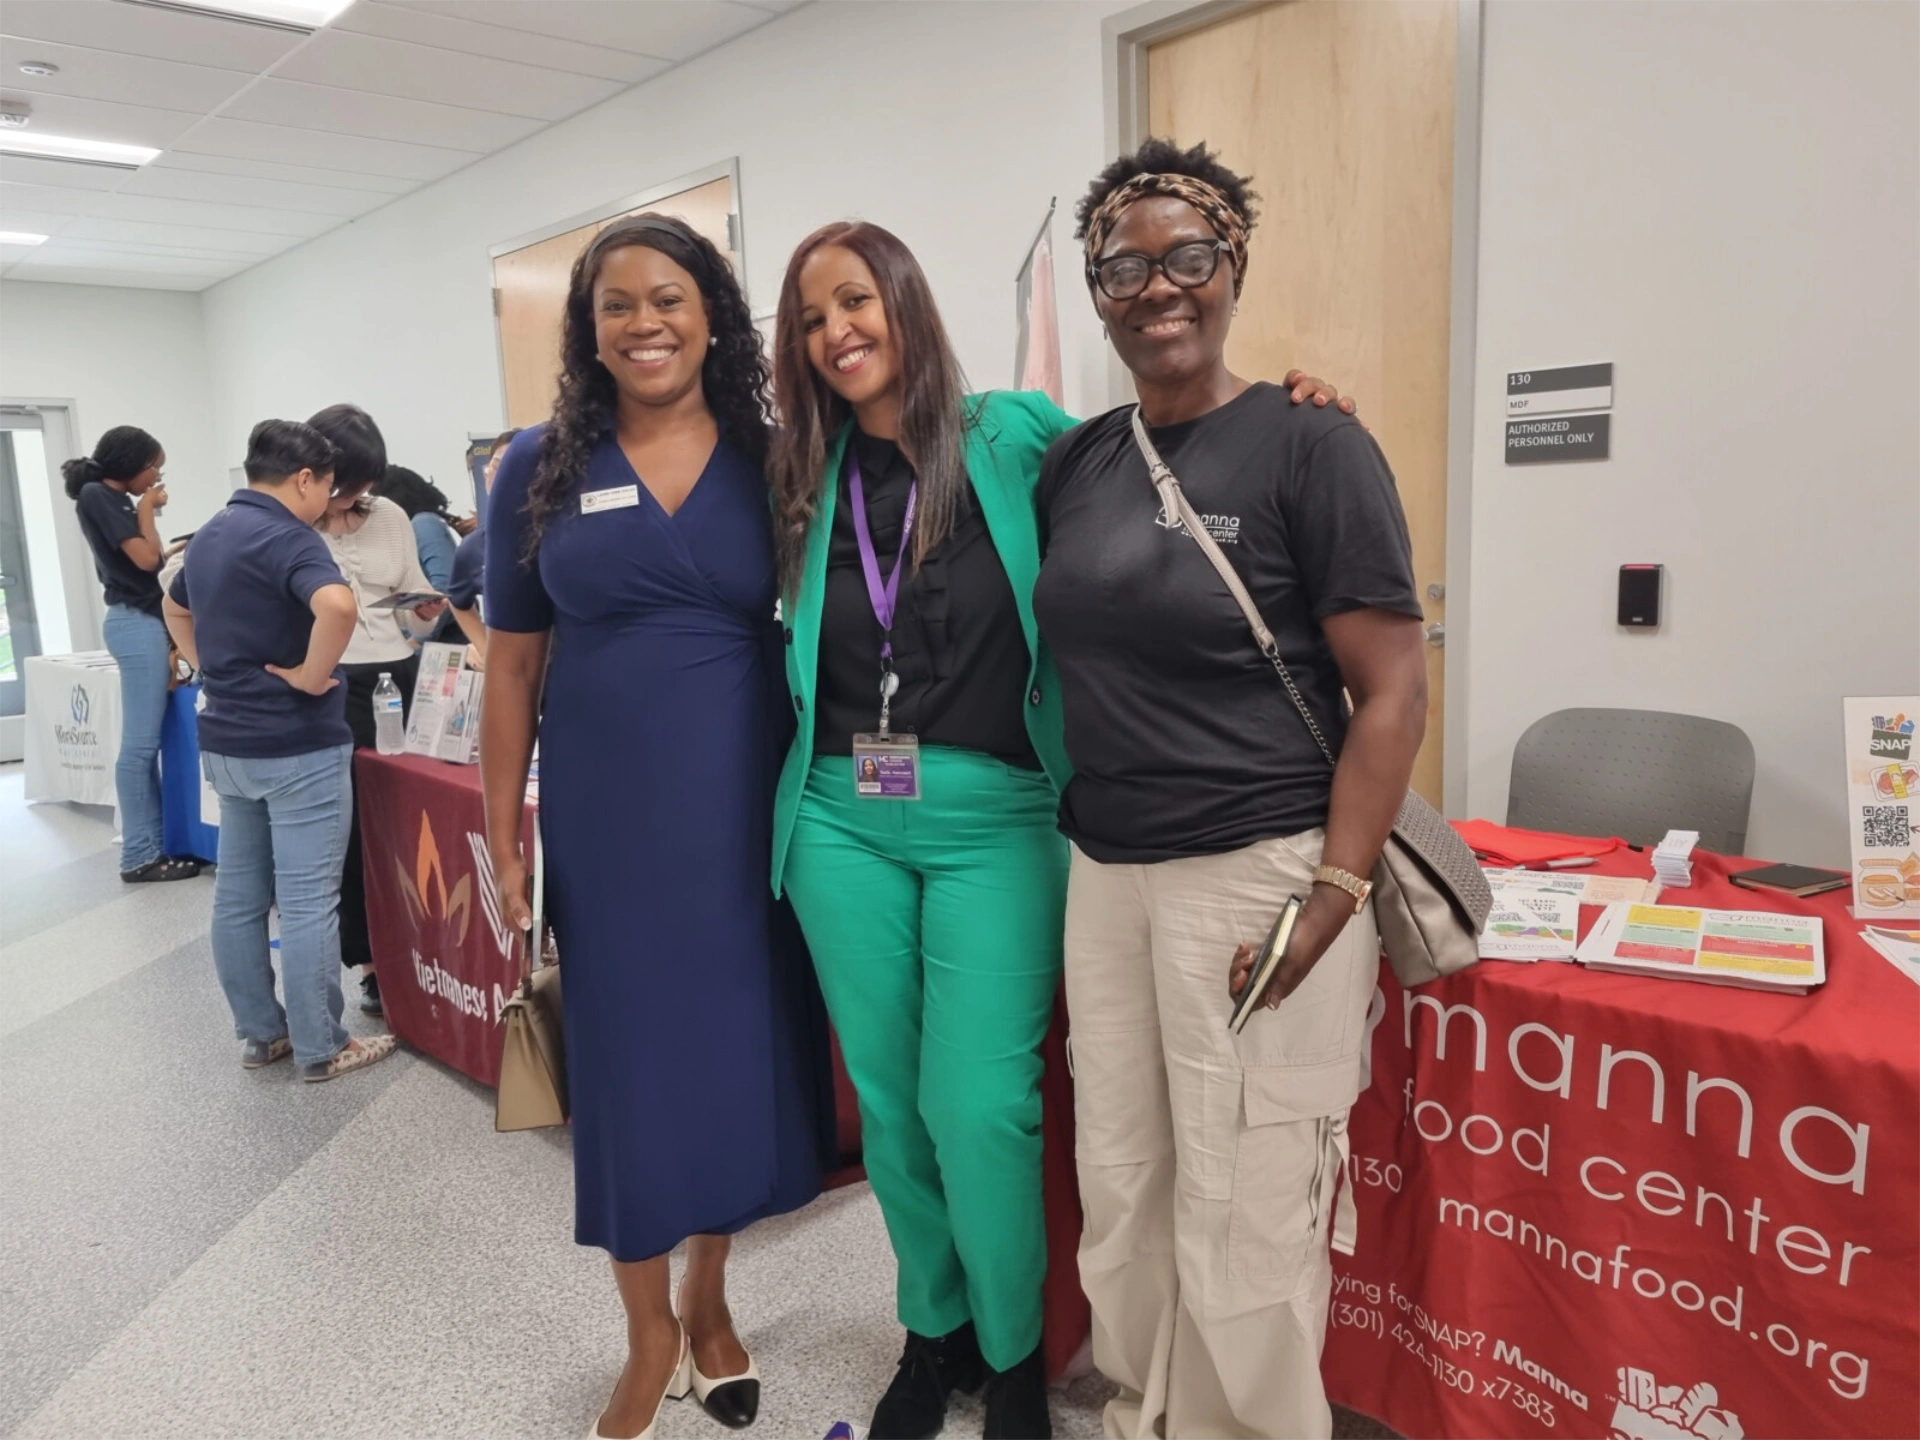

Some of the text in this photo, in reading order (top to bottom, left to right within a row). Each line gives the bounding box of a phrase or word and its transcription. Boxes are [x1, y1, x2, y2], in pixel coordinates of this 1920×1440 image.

[1510, 373, 1531, 385] 130
[1510, 400, 1529, 409] MDF
[1508, 421, 1570, 435] AUTHORIZED
[1508, 432, 1595, 448] PERSONNEL ONLY
[1199, 513, 1240, 527] anna
[1871, 739, 1911, 751] SNAP
[412, 947, 487, 1022] Vietnamese
[1403, 989, 1870, 1195] manna
[1403, 1077, 1872, 1286] food center
[1439, 1196, 1869, 1399] mannafood.org
[1330, 1300, 1556, 1429] (301) 424-1130 x7383
[1388, 1283, 1413, 1317] for
[1414, 1304, 1486, 1357] SNAP?
[1492, 1338, 1589, 1412] Manna
